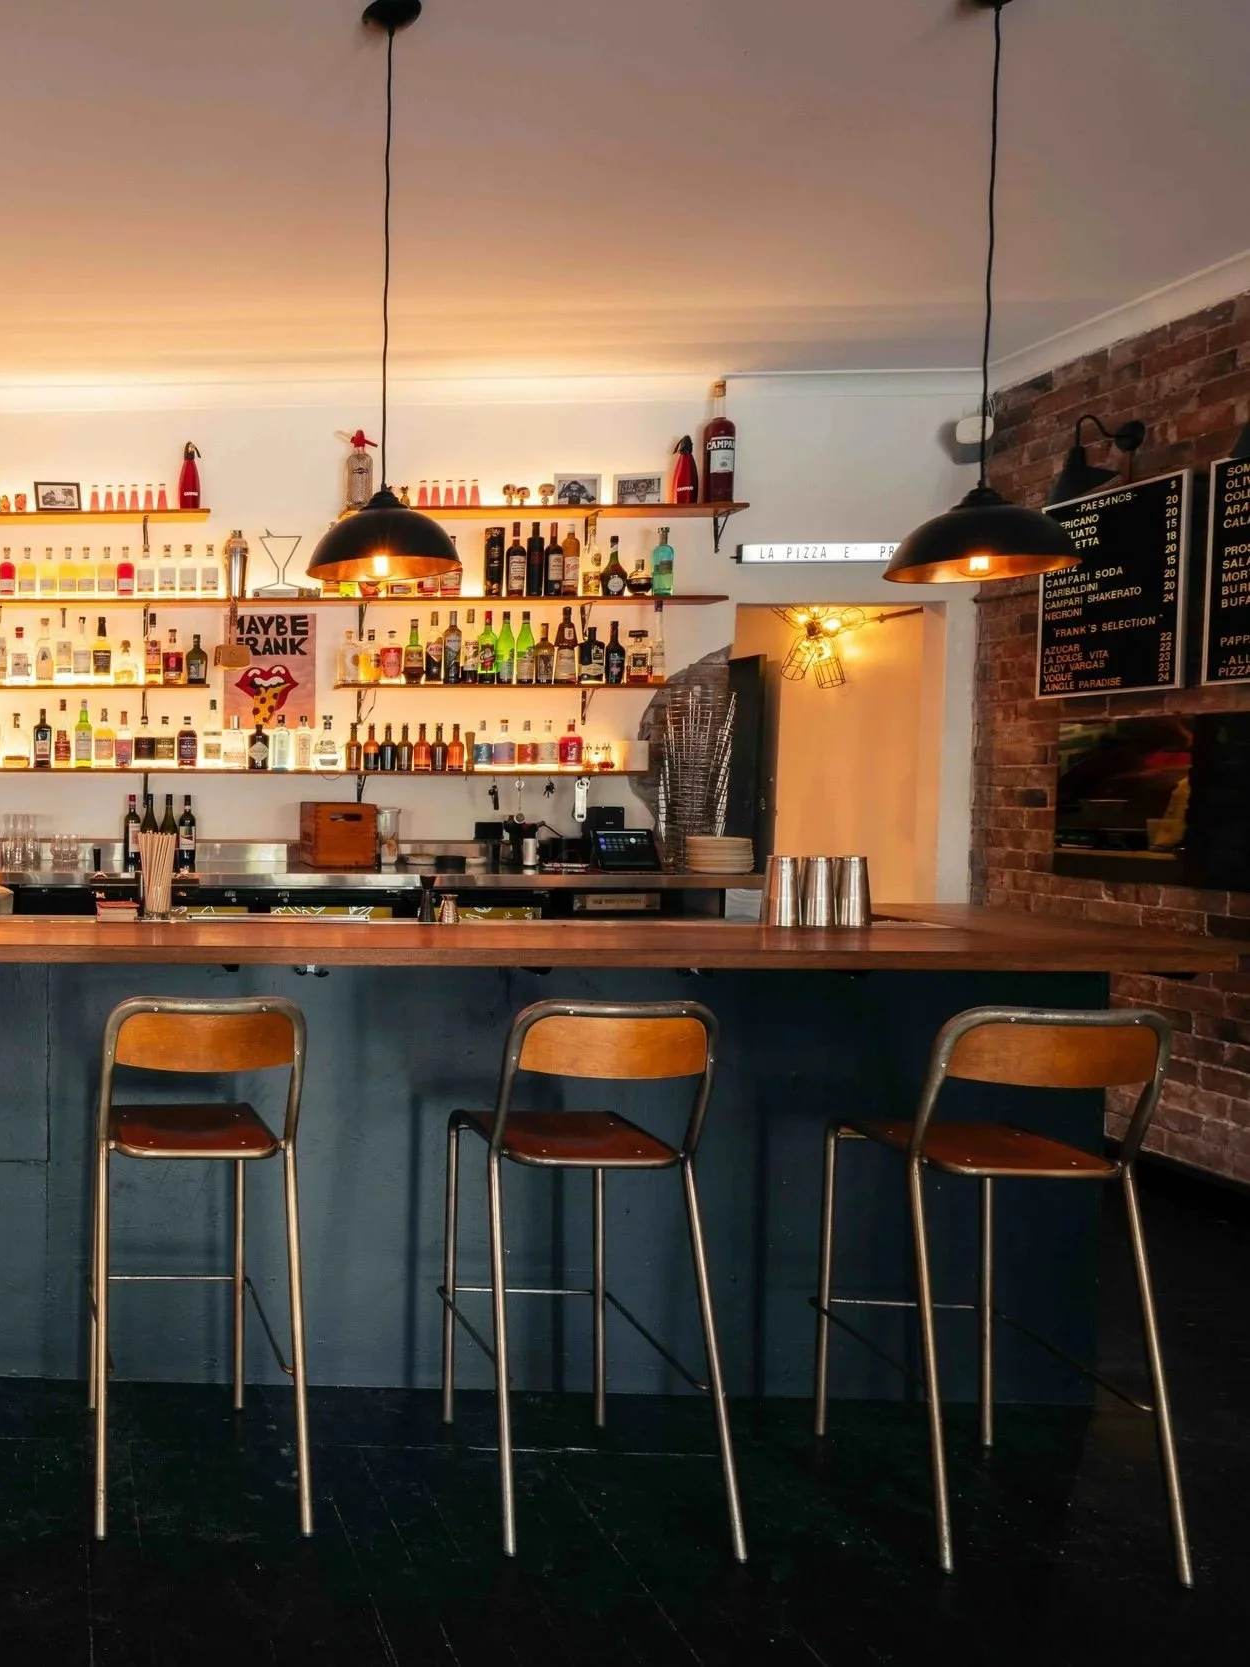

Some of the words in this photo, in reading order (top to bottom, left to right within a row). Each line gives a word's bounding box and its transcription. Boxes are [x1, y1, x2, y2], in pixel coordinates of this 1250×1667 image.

[1166, 495, 1179, 504] 20
[1068, 526, 1097, 540] LIATO
[1166, 508, 1178, 516] 20
[1075, 536, 1099, 549] ETTA
[1166, 520, 1177, 528] 15
[1167, 532, 1177, 540] 18
[760, 547, 774, 559] LA
[786, 546, 827, 559] PIZZA
[1165, 544, 1177, 553] 20
[1046, 572, 1090, 588] CAMPARI
[1095, 567, 1123, 578] SODA
[1167, 556, 1176, 565] 15
[1222, 570, 1250, 583] MOR
[1046, 583, 1098, 599] GARIBALDINI
[1164, 569, 1176, 578] 20
[1045, 597, 1082, 610] CAMPARI
[1087, 587, 1142, 603] SHAKERATO
[1164, 582, 1175, 590] 20
[1045, 608, 1082, 621] NEGRONI
[1163, 593, 1174, 602] 24
[1044, 644, 1080, 655] AZUCAR
[1160, 632, 1172, 641] 22
[1220, 635, 1250, 647] PAPP
[1043, 664, 1065, 674] LADY
[1070, 660, 1105, 670] VARGAS
[1159, 653, 1170, 662] 23
[1044, 655, 1053, 664] LA
[1057, 653, 1082, 663] DOLCE
[1090, 650, 1109, 659] VITA
[1160, 643, 1171, 651] 22
[1043, 673, 1072, 682] VOGUE
[1158, 663, 1170, 672] 23
[1043, 681, 1075, 692] JUNGLE
[1079, 677, 1121, 688] PARADISE
[1158, 673, 1169, 682] 24
